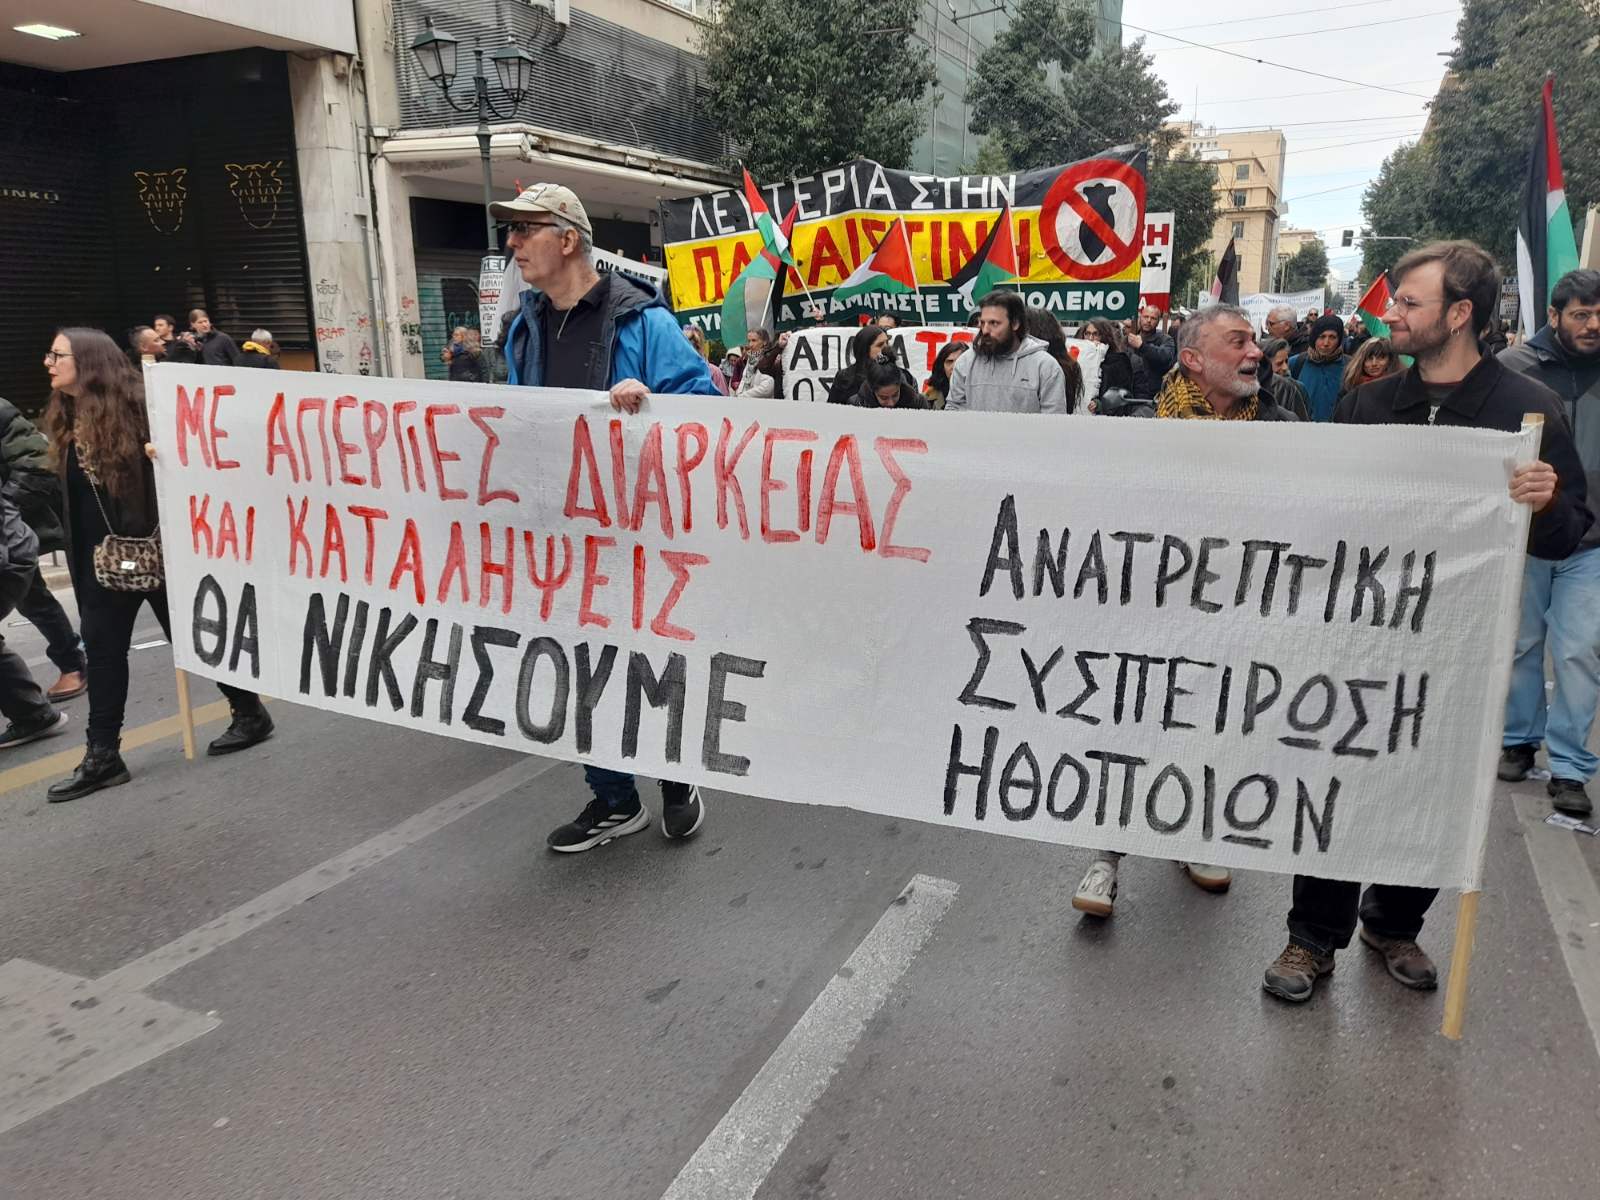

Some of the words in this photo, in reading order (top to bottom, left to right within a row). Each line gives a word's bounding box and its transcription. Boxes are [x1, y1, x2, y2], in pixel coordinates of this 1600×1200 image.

[909, 174, 1016, 209] ΣΤΗΝ
[176, 384, 240, 471] ΜΕ
[266, 391, 520, 506] ΑΠΕΡΓΙΕΣ
[563, 413, 932, 563] ΔΙΑΡΚΕΙΑΣ
[189, 493, 255, 566] ΚΑΙ
[286, 493, 710, 641] ΚΑΤΑΛΗΨΕΙΣ
[979, 493, 1437, 633] ΑΝΑΤΡΕΠΤΙΚΗ
[192, 573, 260, 680] ΘΑ
[299, 591, 767, 777] ΝΙΚΗΣΟΥΜΕ
[957, 616, 1429, 759] ΣΥΣΠΕΙΡΩΣΗ
[943, 724, 1342, 855] ΗΘΟΠΟΙΩΝ
